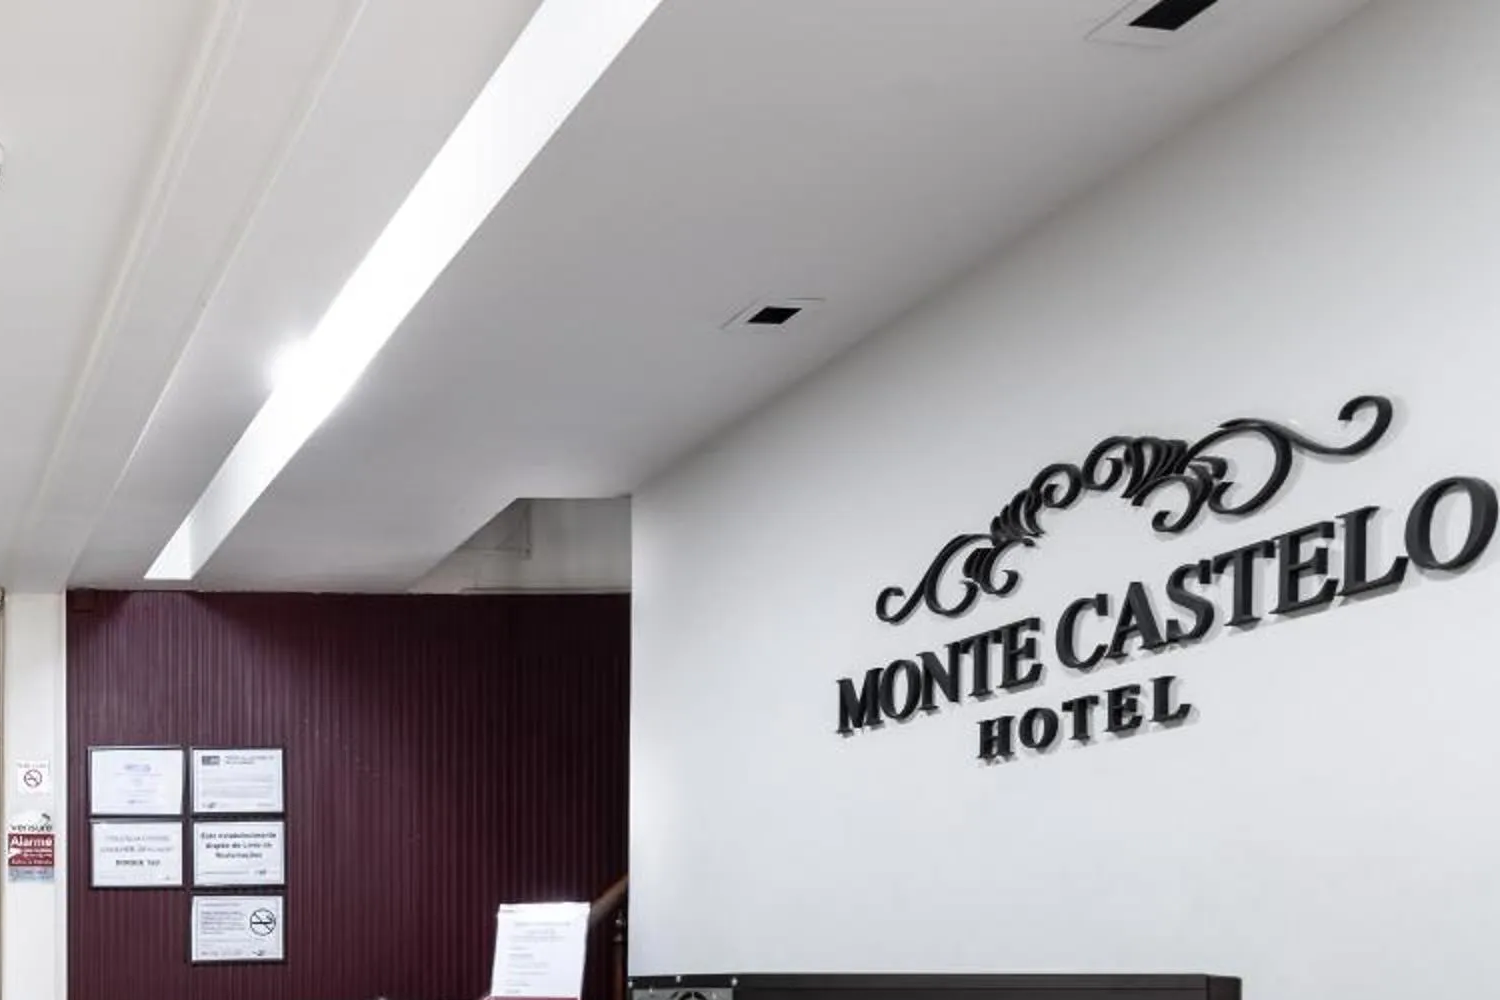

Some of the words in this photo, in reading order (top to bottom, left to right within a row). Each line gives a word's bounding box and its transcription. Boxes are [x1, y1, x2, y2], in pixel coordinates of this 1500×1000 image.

[835, 617, 1043, 735] MONTE
[1056, 476, 1499, 671] CASTELO
[977, 676, 1192, 759] HOTEL
[11, 835, 53, 847] Alarme
